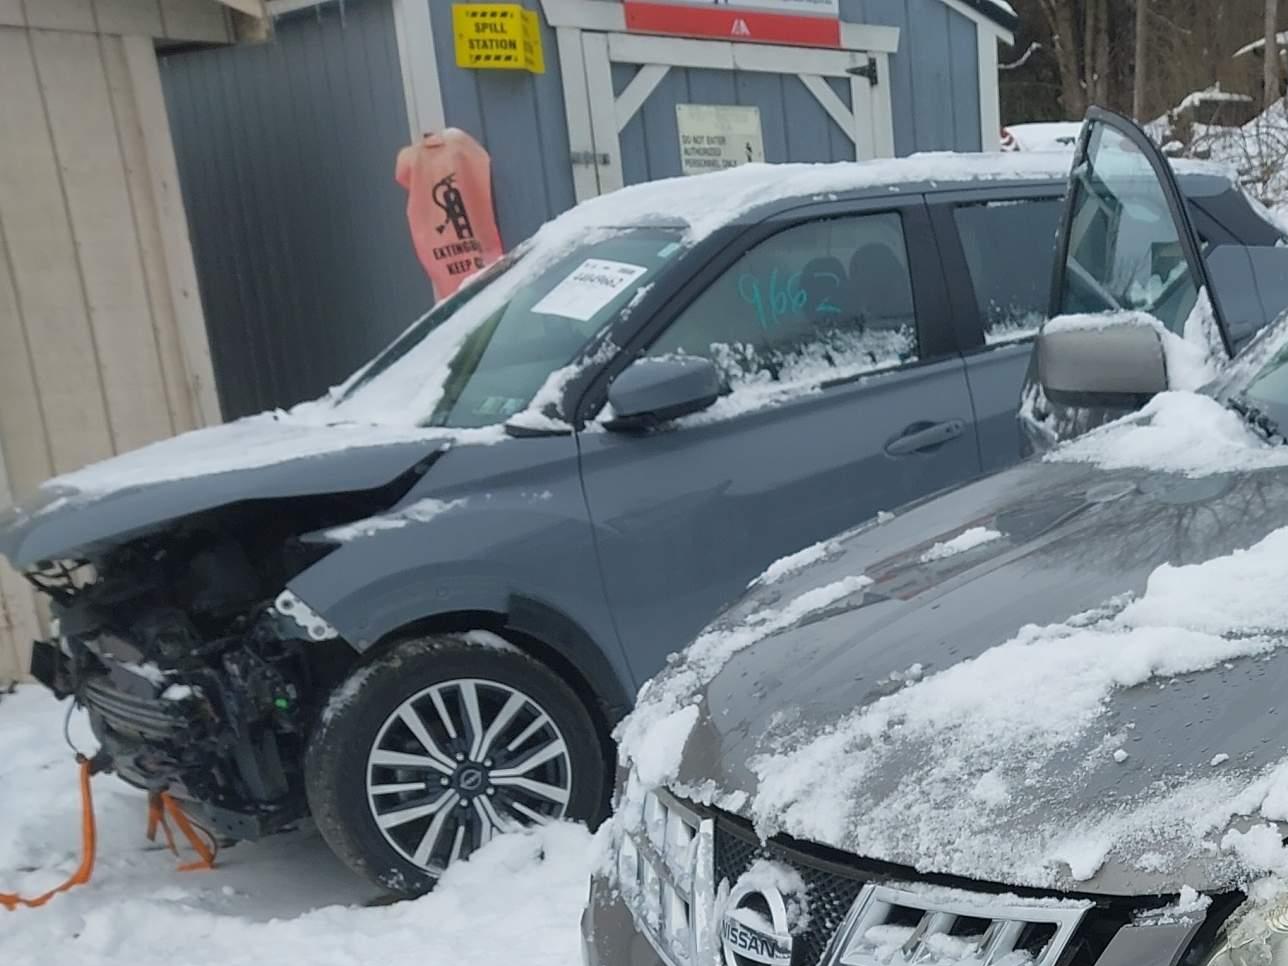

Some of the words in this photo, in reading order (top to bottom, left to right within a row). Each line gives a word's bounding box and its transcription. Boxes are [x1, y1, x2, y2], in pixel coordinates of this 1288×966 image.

[474, 22, 507, 33] SPILL
[468, 38, 516, 49] STATION
[446, 259, 471, 275] KEEP
[723, 919, 775, 958] NISSAN
